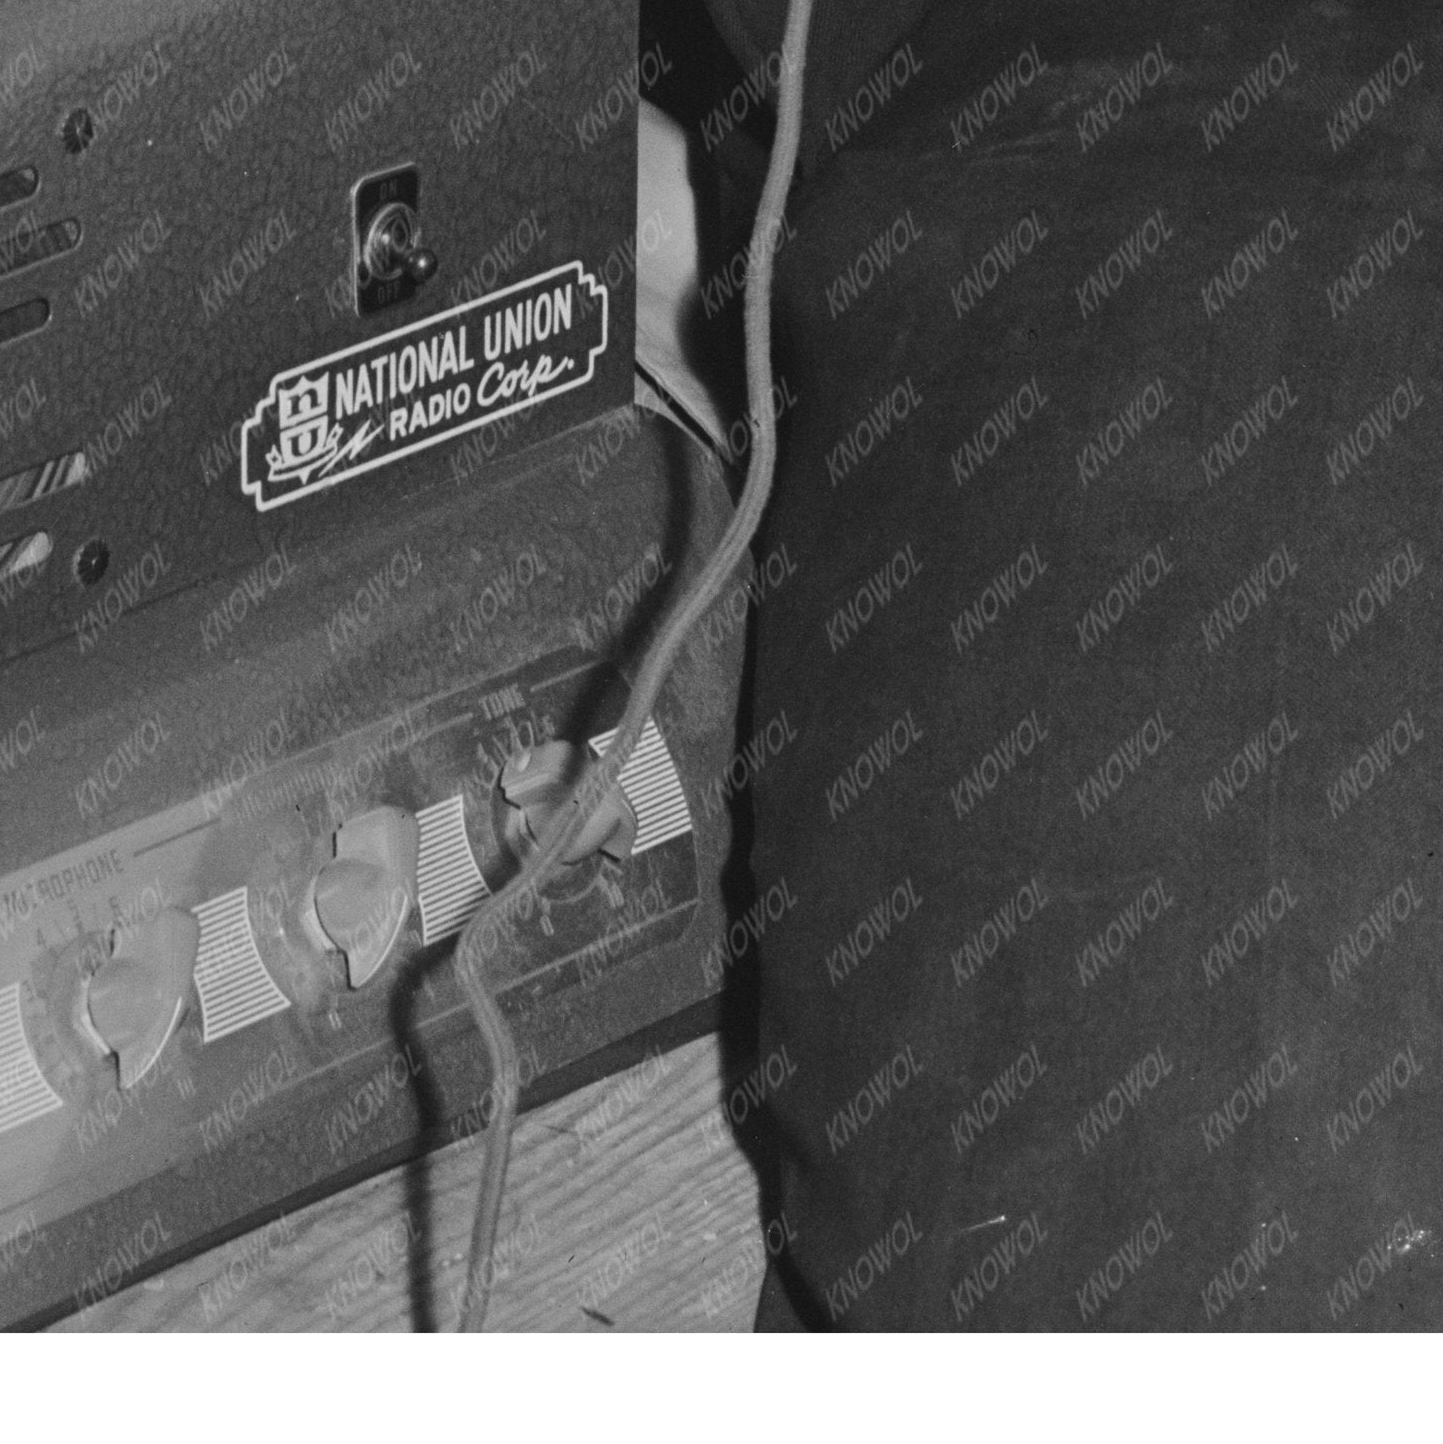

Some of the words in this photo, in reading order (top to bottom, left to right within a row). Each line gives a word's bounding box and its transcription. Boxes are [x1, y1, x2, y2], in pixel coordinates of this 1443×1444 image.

[335, 326, 475, 420] NATIONAL
[484, 284, 574, 361] UNION
[389, 383, 471, 441] RADIO
[477, 355, 575, 408] Corp.
